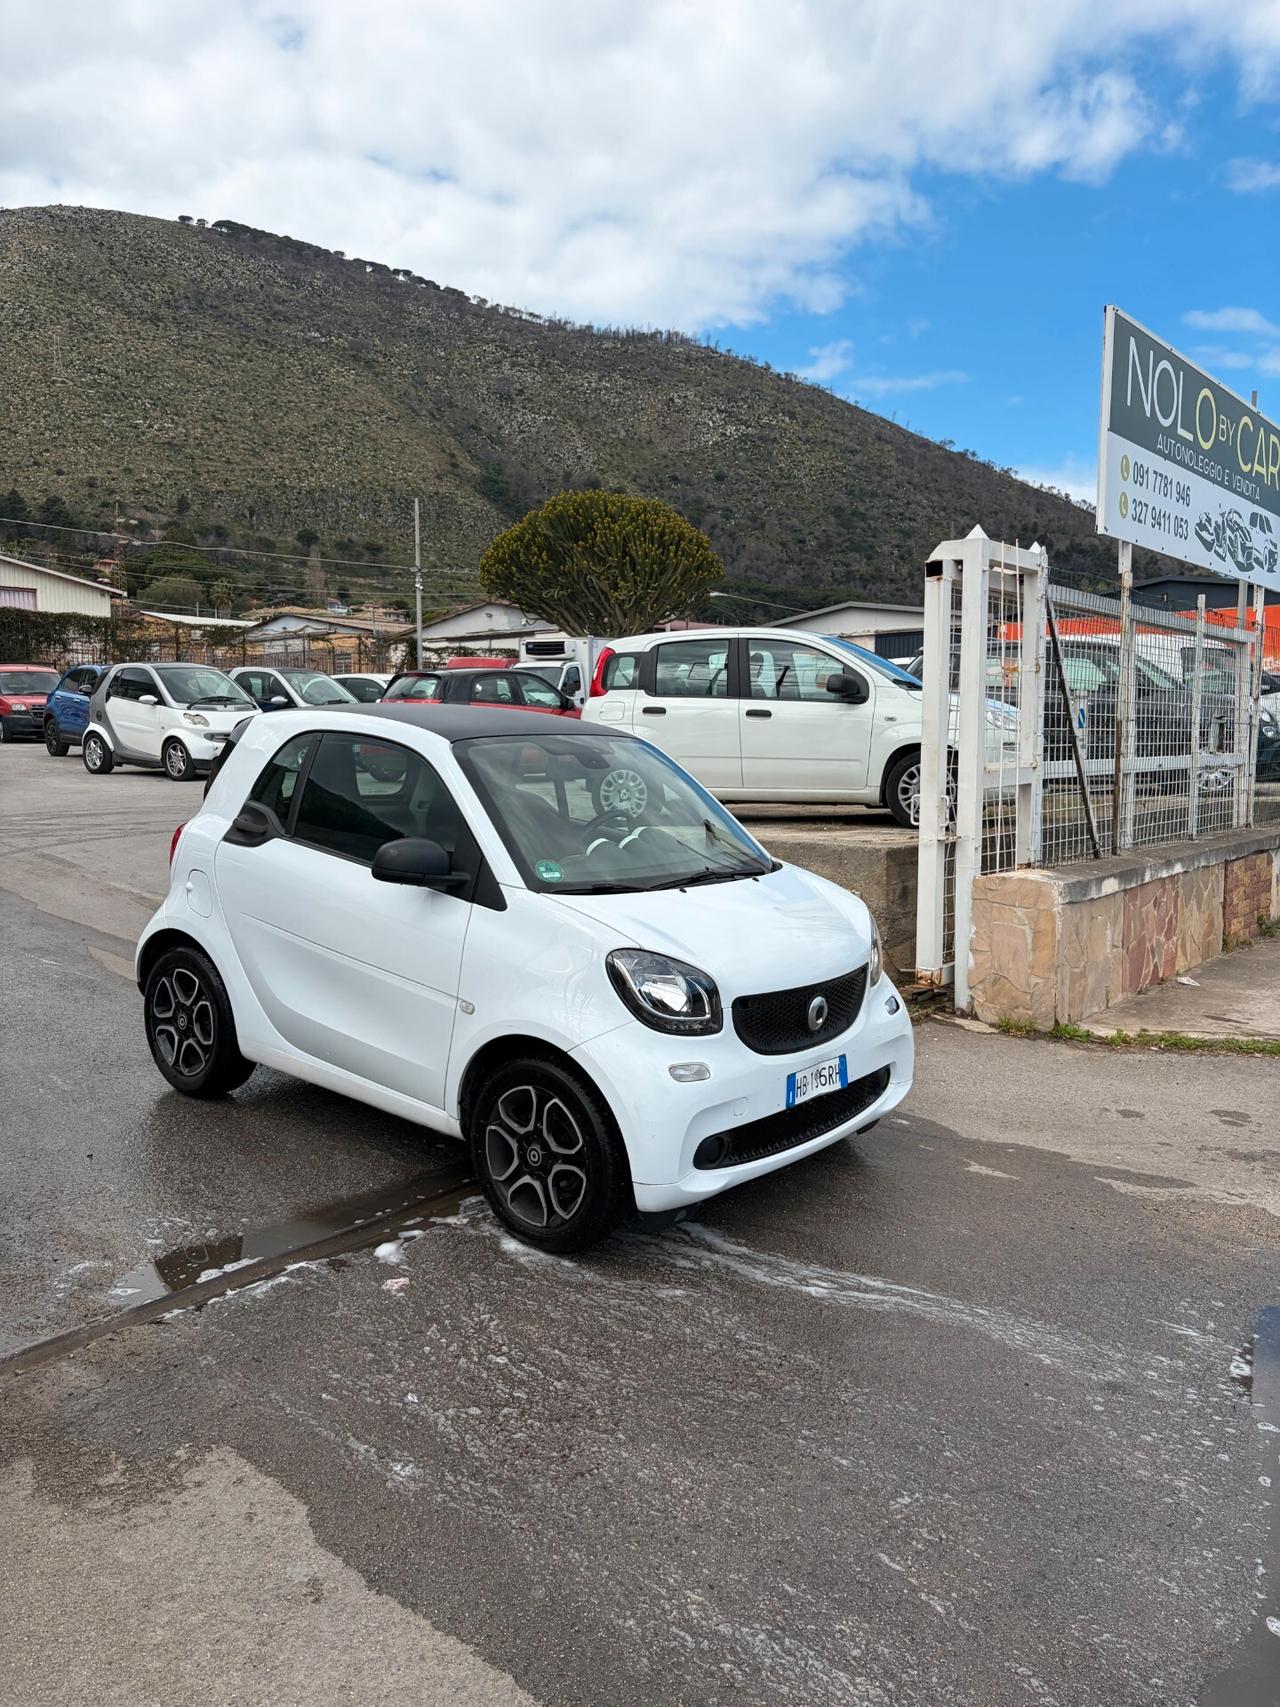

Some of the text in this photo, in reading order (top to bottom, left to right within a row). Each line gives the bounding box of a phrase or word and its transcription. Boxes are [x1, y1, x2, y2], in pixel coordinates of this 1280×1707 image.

[1127, 336, 1216, 450] NOLO
[1219, 415, 1236, 446] BY
[1133, 460, 1191, 507] 091 7781 946
[1157, 433, 1260, 501] AUTONOLEGGIO E VENDITA
[1132, 498, 1189, 540] 327 9411 053
